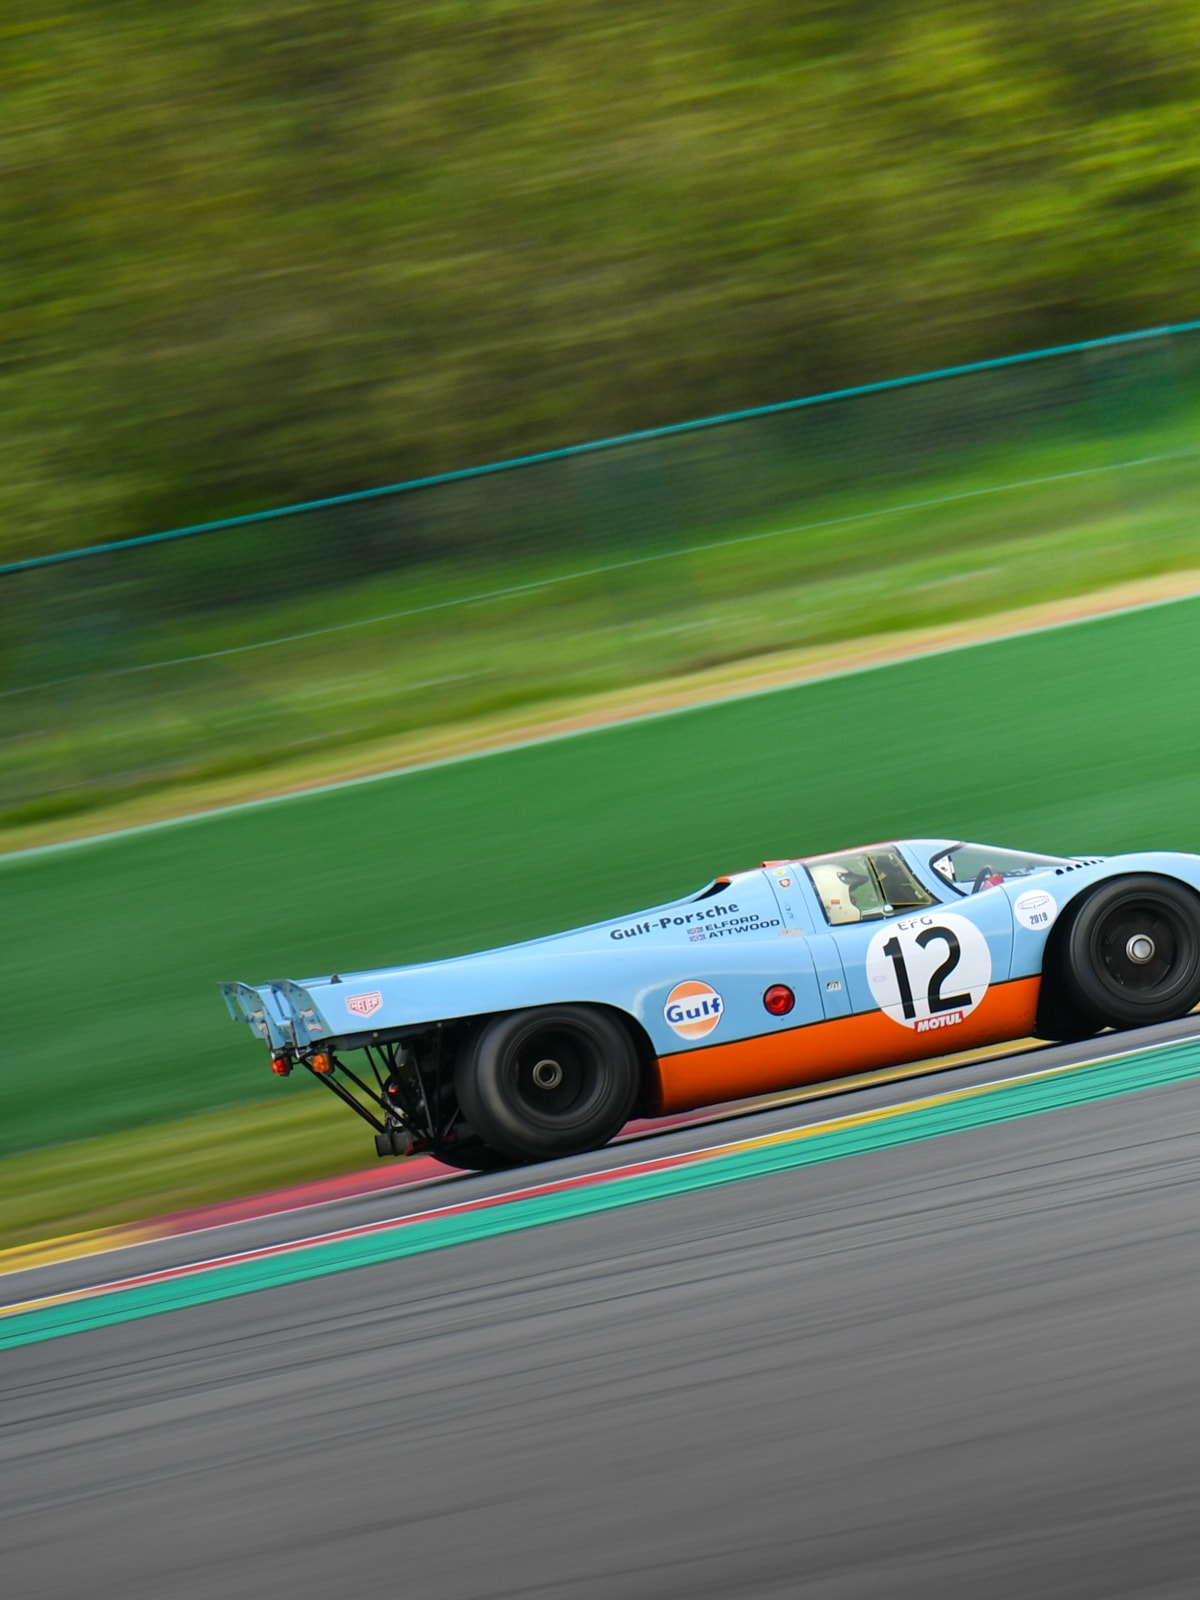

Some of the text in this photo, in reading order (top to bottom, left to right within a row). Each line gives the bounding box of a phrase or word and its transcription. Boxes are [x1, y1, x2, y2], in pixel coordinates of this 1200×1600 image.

[610, 903, 739, 941] Gulf-Porsche
[705, 914, 759, 931] ELFORD
[1029, 911, 1048, 925] 2019
[709, 919, 780, 939] ATTWOOD
[882, 926, 973, 1019] 12
[350, 996, 379, 1012] HEUER
[666, 998, 721, 1023] Gulf
[917, 1012, 963, 1033] MOTUL
